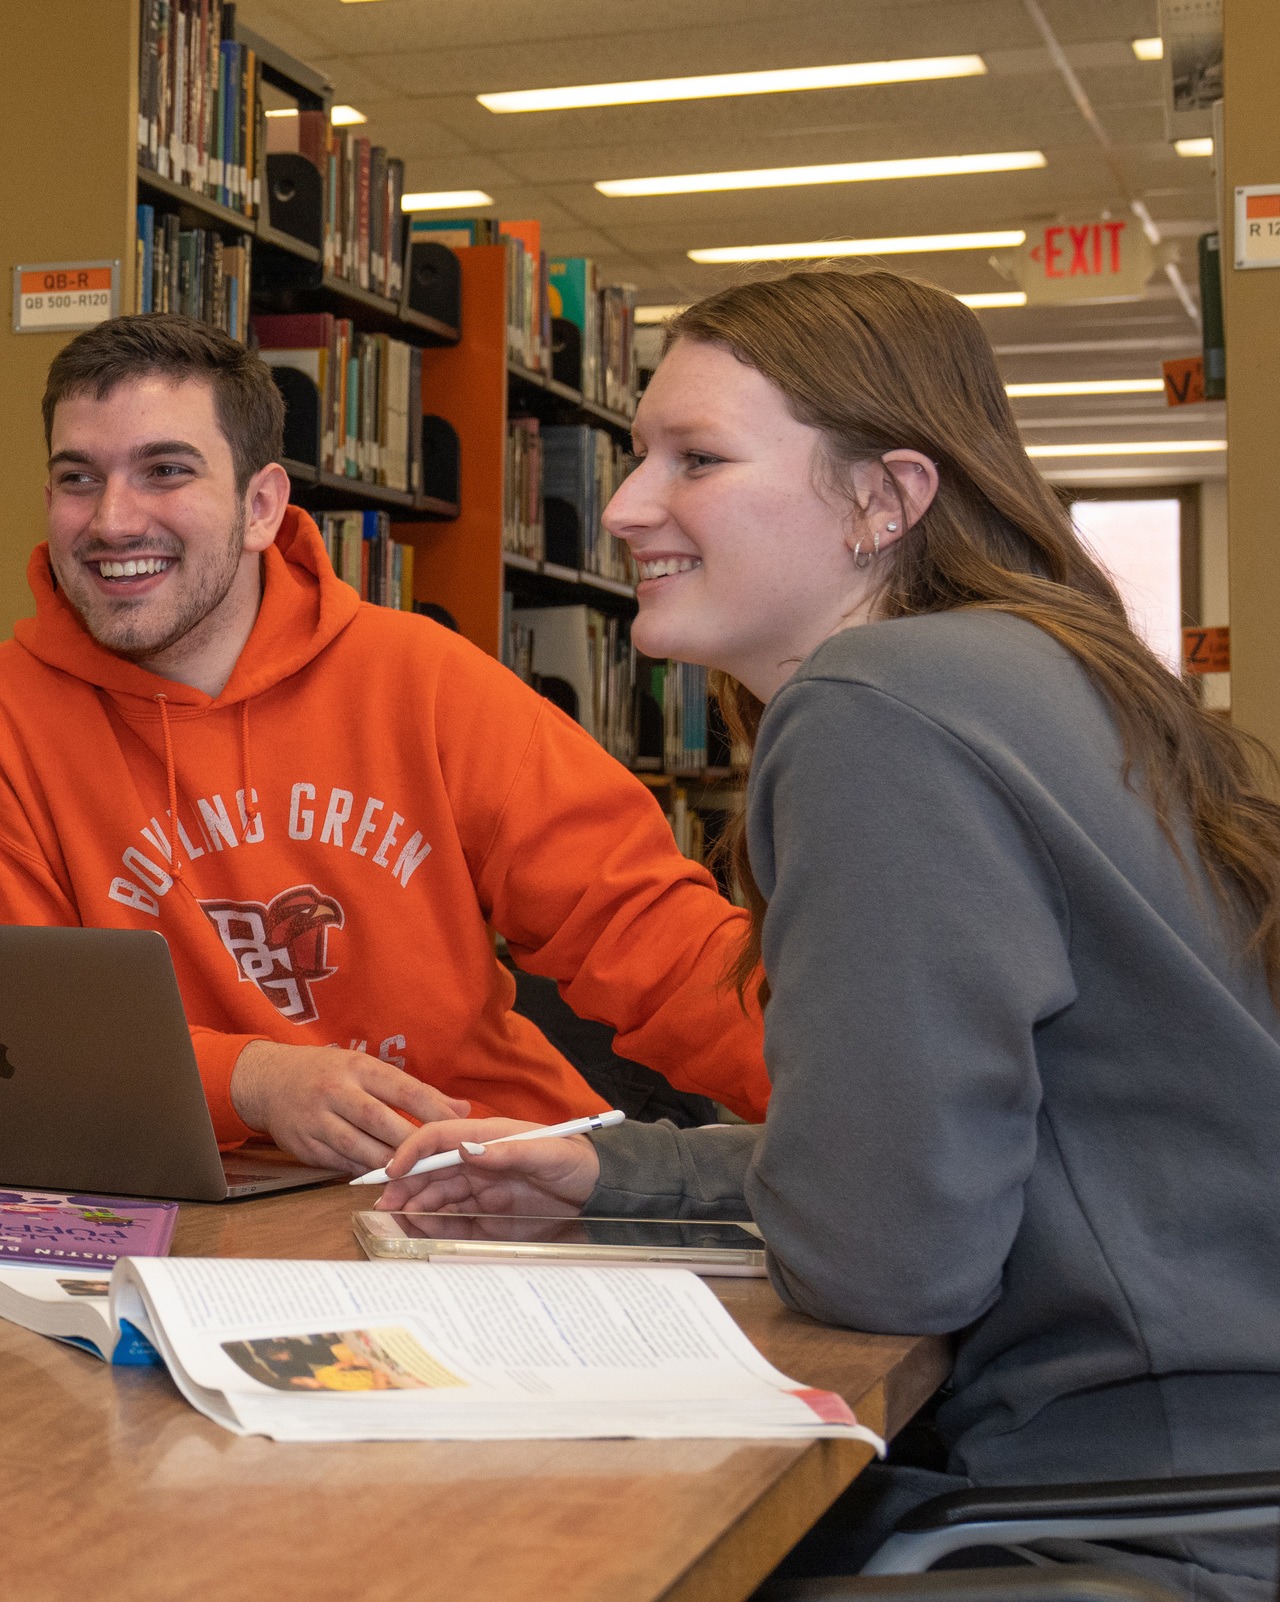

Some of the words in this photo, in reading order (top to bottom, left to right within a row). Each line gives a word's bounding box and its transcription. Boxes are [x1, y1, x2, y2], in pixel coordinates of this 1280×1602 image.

[1249, 223, 1262, 238] R
[1044, 222, 1126, 278] EXIT
[43, 272, 89, 290] QB-R
[25, 296, 44, 310] QB
[47, 293, 108, 309] 500-R120
[1166, 370, 1191, 404] V
[1186, 632, 1209, 663] Z
[108, 787, 265, 917] BOWLNG
[287, 782, 432, 889] GREEN
[73, 1236, 122, 1246] The
[34, 1247, 117, 1261] RISTEN
